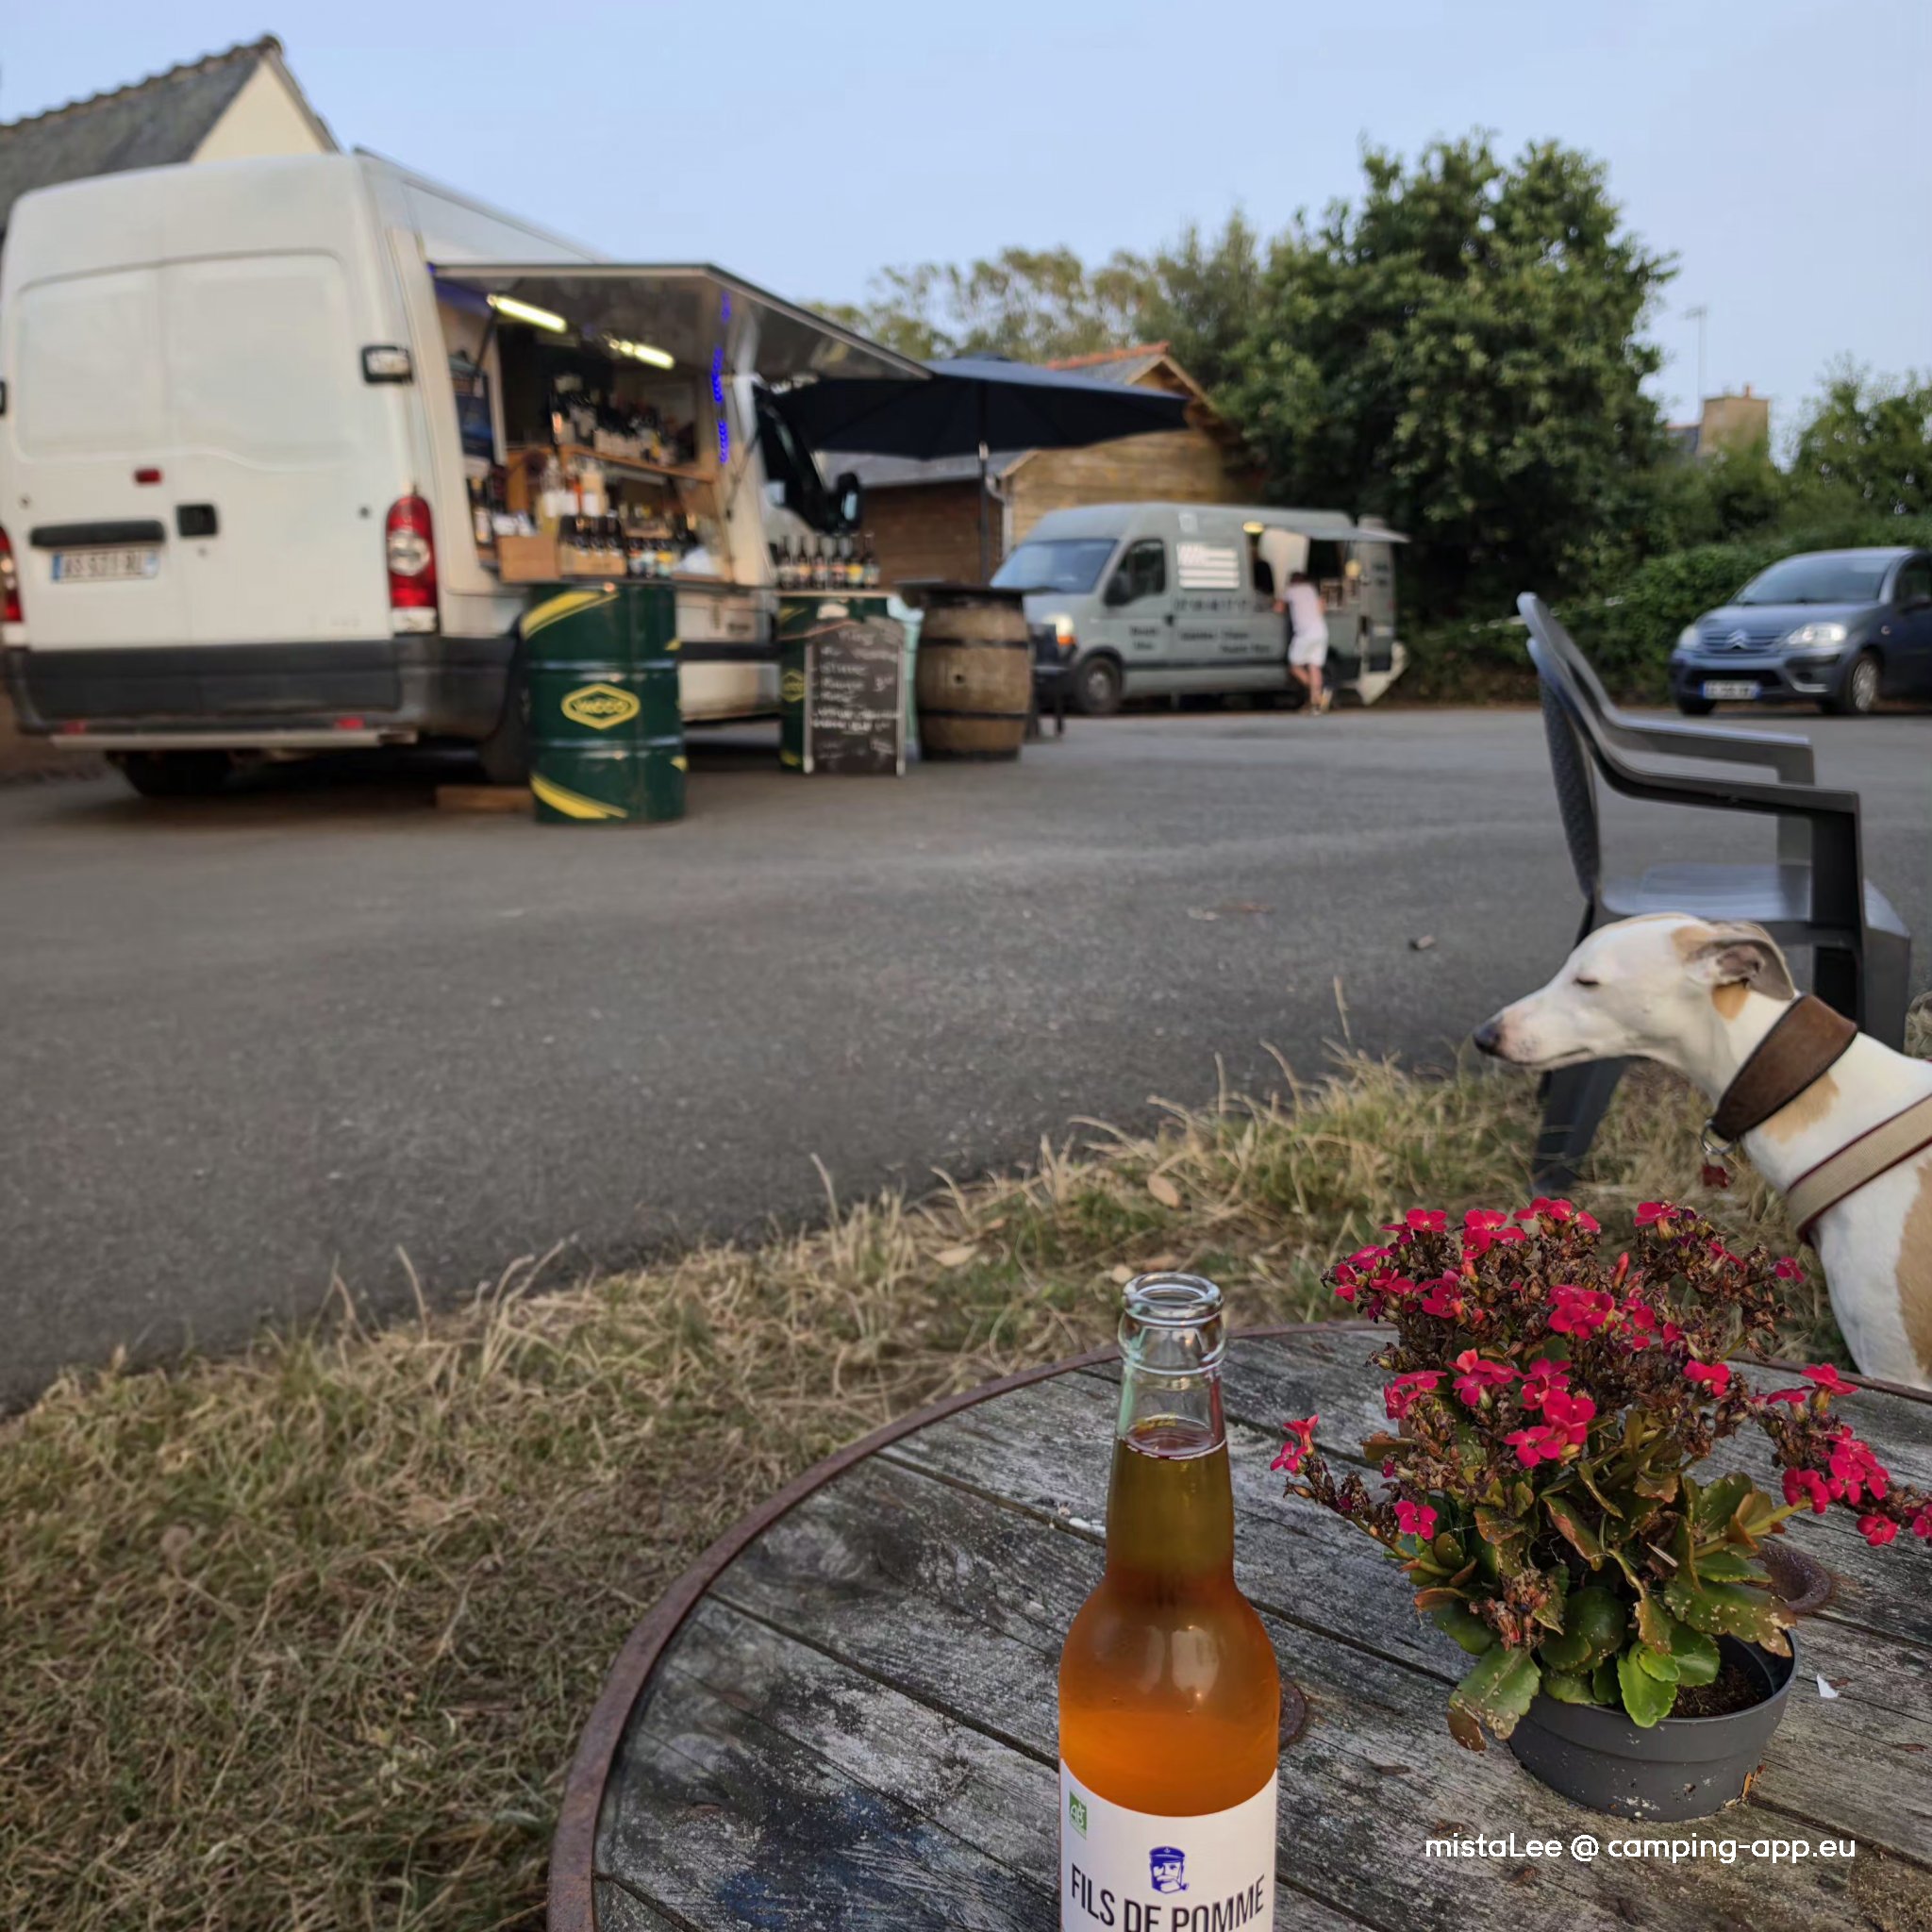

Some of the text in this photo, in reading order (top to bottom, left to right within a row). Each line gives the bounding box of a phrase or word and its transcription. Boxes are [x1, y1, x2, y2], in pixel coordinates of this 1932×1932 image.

[1072, 1862, 1265, 1932] FILS DE POMME
